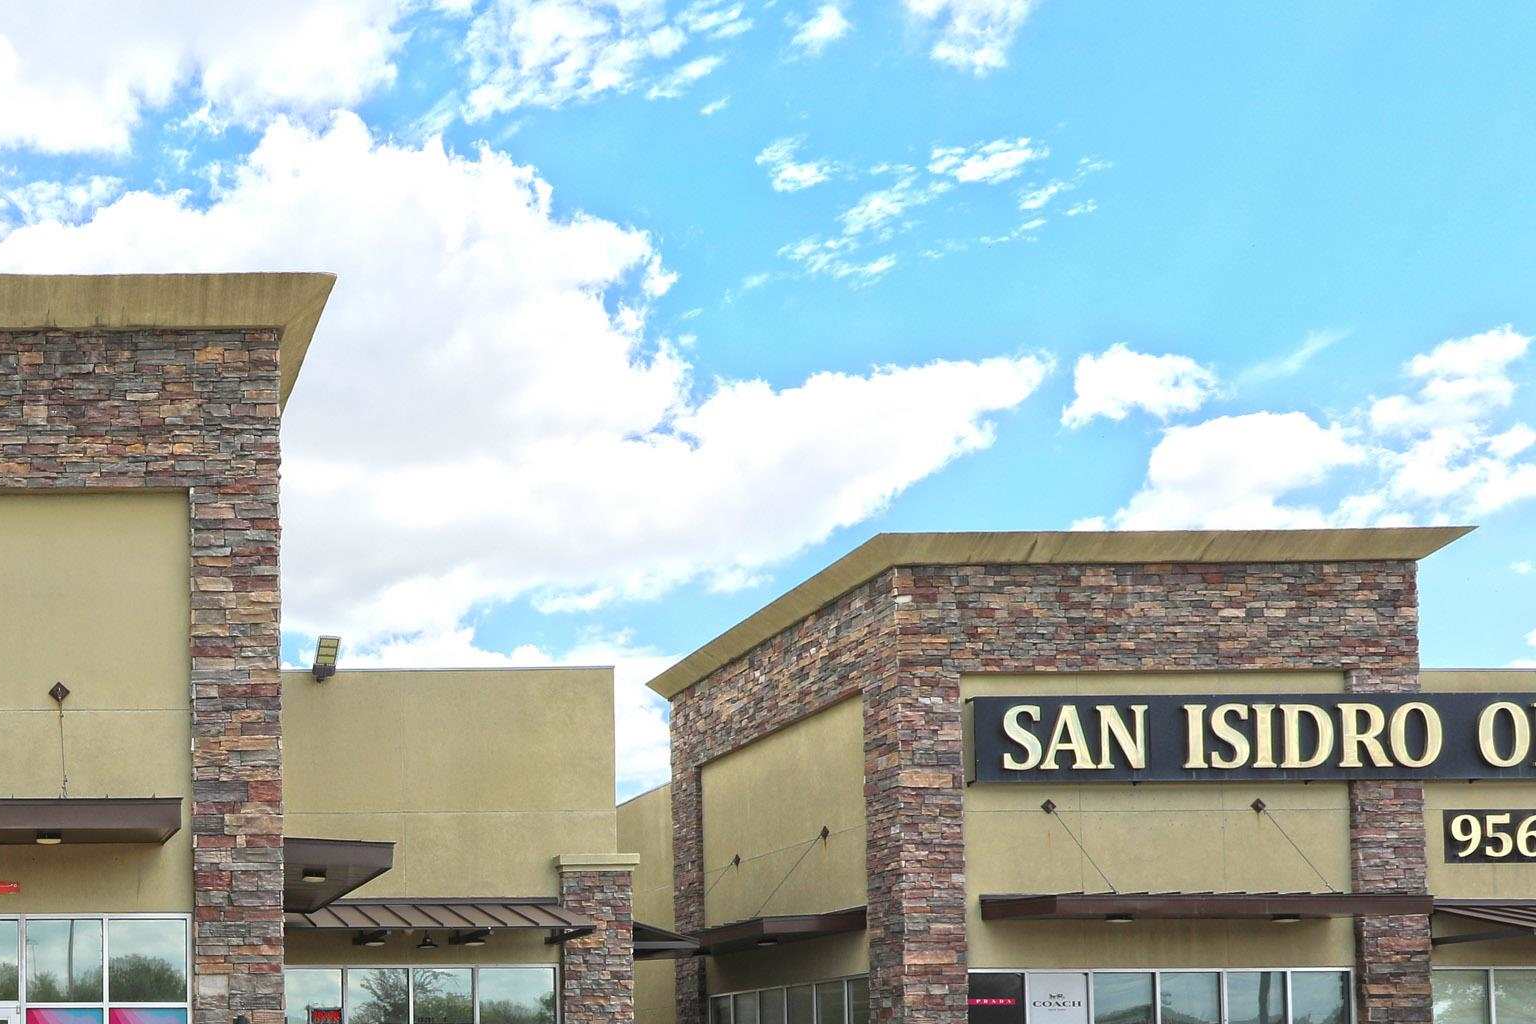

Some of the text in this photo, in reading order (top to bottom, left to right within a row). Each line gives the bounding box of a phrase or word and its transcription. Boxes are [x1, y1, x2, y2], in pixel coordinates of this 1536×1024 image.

[1002, 701, 1536, 770] SAN ISIDRO O
[1451, 813, 1536, 858] 956
[1032, 1000, 1082, 1008] COACH
